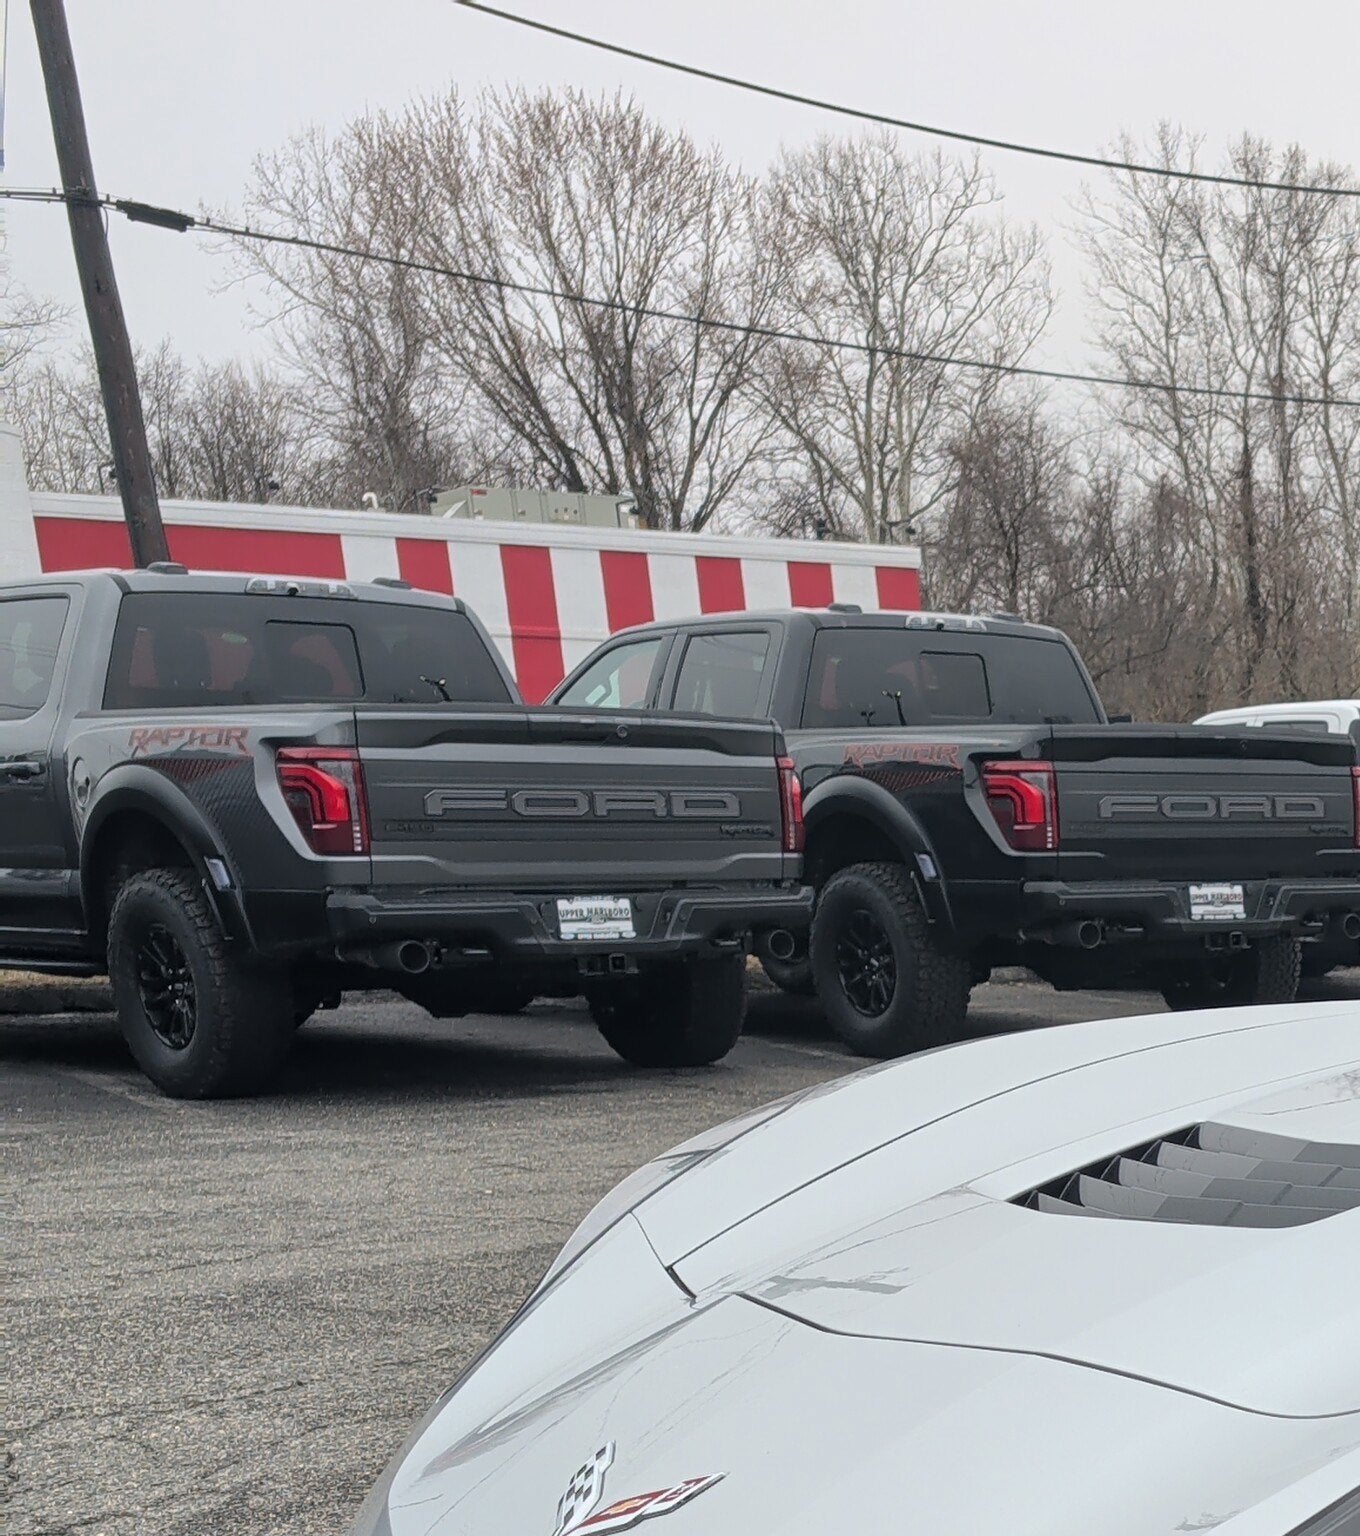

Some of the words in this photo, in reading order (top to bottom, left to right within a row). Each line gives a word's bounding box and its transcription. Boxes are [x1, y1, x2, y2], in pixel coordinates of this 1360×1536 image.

[128, 726, 254, 757] RAPTOR
[423, 788, 741, 818] FORD
[1099, 795, 1325, 818] FORD
